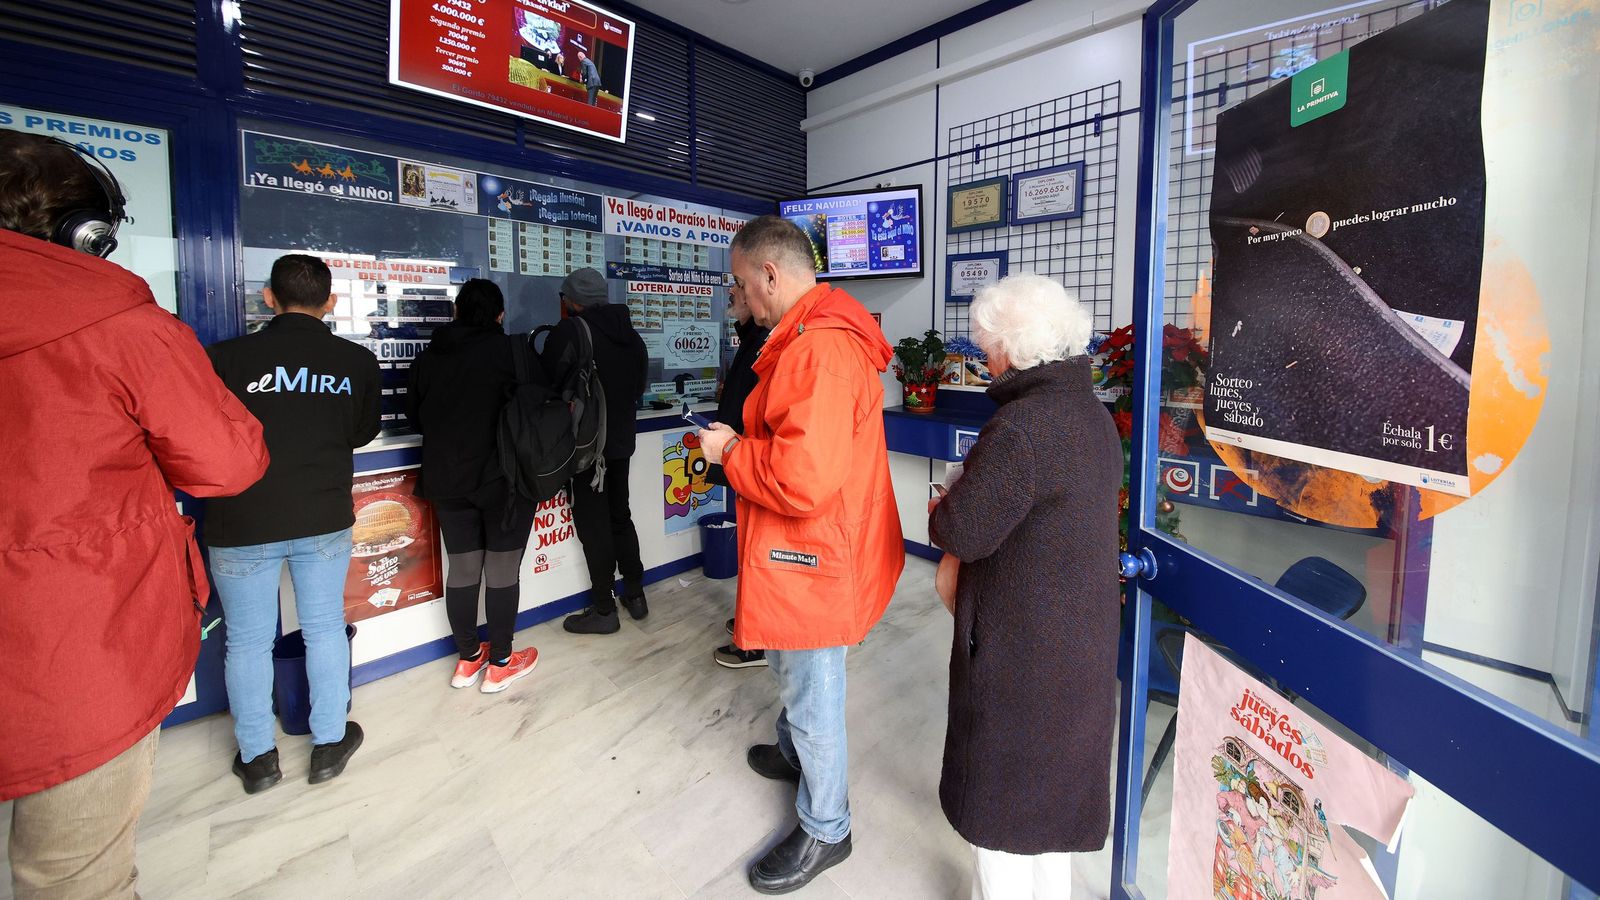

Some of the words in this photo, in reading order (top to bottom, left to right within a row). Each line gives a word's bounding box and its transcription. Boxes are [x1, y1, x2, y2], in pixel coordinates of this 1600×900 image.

[432, 3, 476, 23] 4.000.000
[430, 15, 460, 30] Segundo
[461, 26, 486, 38] premio
[435, 46, 456, 57] Tercer
[456, 53, 479, 64] premio
[462, 87, 485, 99] Gordo
[510, 100, 536, 112] vendido
[547, 110, 569, 120] Madrid
[1306, 91, 1339, 109] PRIMITIVA
[25, 115, 161, 145] PREMIOS
[75, 142, 137, 161] ÑOS
[250, 172, 278, 186] ¡Ya
[282, 176, 325, 194] llegó
[329, 184, 344, 195] el
[348, 185, 393, 201] NIÑO!
[1025, 185, 1064, 197] 16.269.652
[529, 189, 558, 205] ¡Regala
[560, 192, 585, 207] ilusión!
[963, 196, 990, 206] 19570
[538, 207, 569, 223] ¡Regala
[607, 198, 624, 215] Ya
[627, 201, 654, 221] llegó
[656, 208, 666, 221] al
[669, 208, 705, 228] Paraíso
[708, 215, 716, 229] la
[719, 217, 745, 232] Navid
[784, 203, 813, 214] ¡FELIZ
[1247, 235, 1261, 245] Por
[1263, 232, 1280, 243] muy
[1281, 228, 1302, 241] poco
[1332, 213, 1370, 230] puedes
[1372, 206, 1409, 222] lograr
[1410, 195, 1457, 214] mucho
[617, 220, 681, 237] ¡VAMOS
[686, 230, 696, 240] A
[701, 231, 729, 244] POR
[359, 272, 384, 280] DEL
[388, 273, 423, 282] NIÑO
[391, 263, 446, 274] VIAJERA
[668, 269, 683, 282] Sorteo
[701, 272, 704, 283] 6
[705, 274, 710, 284] de
[710, 275, 721, 285] enero
[630, 283, 676, 293] LOTERIA
[676, 285, 712, 295] JUEVES
[381, 343, 428, 358] CIUDA
[674, 337, 710, 349] 60622
[1216, 373, 1253, 389] Sorteo
[1210, 383, 1242, 400] lunes,
[1215, 396, 1252, 412] jueves
[1224, 410, 1264, 427] sábado
[1383, 420, 1422, 439] Échala
[1383, 437, 1399, 446] por
[1401, 438, 1422, 449] solo
[536, 491, 568, 512] JUEG
[534, 513, 554, 532] NO
[560, 508, 573, 523] SE
[535, 525, 574, 550] JUEGA
[772, 552, 797, 560] Minute
[798, 555, 816, 563] Maid
[371, 576, 383, 586] NOS
[384, 567, 398, 578] UNE
[1237, 689, 1302, 745] jueves
[1230, 707, 1314, 779] sábados
